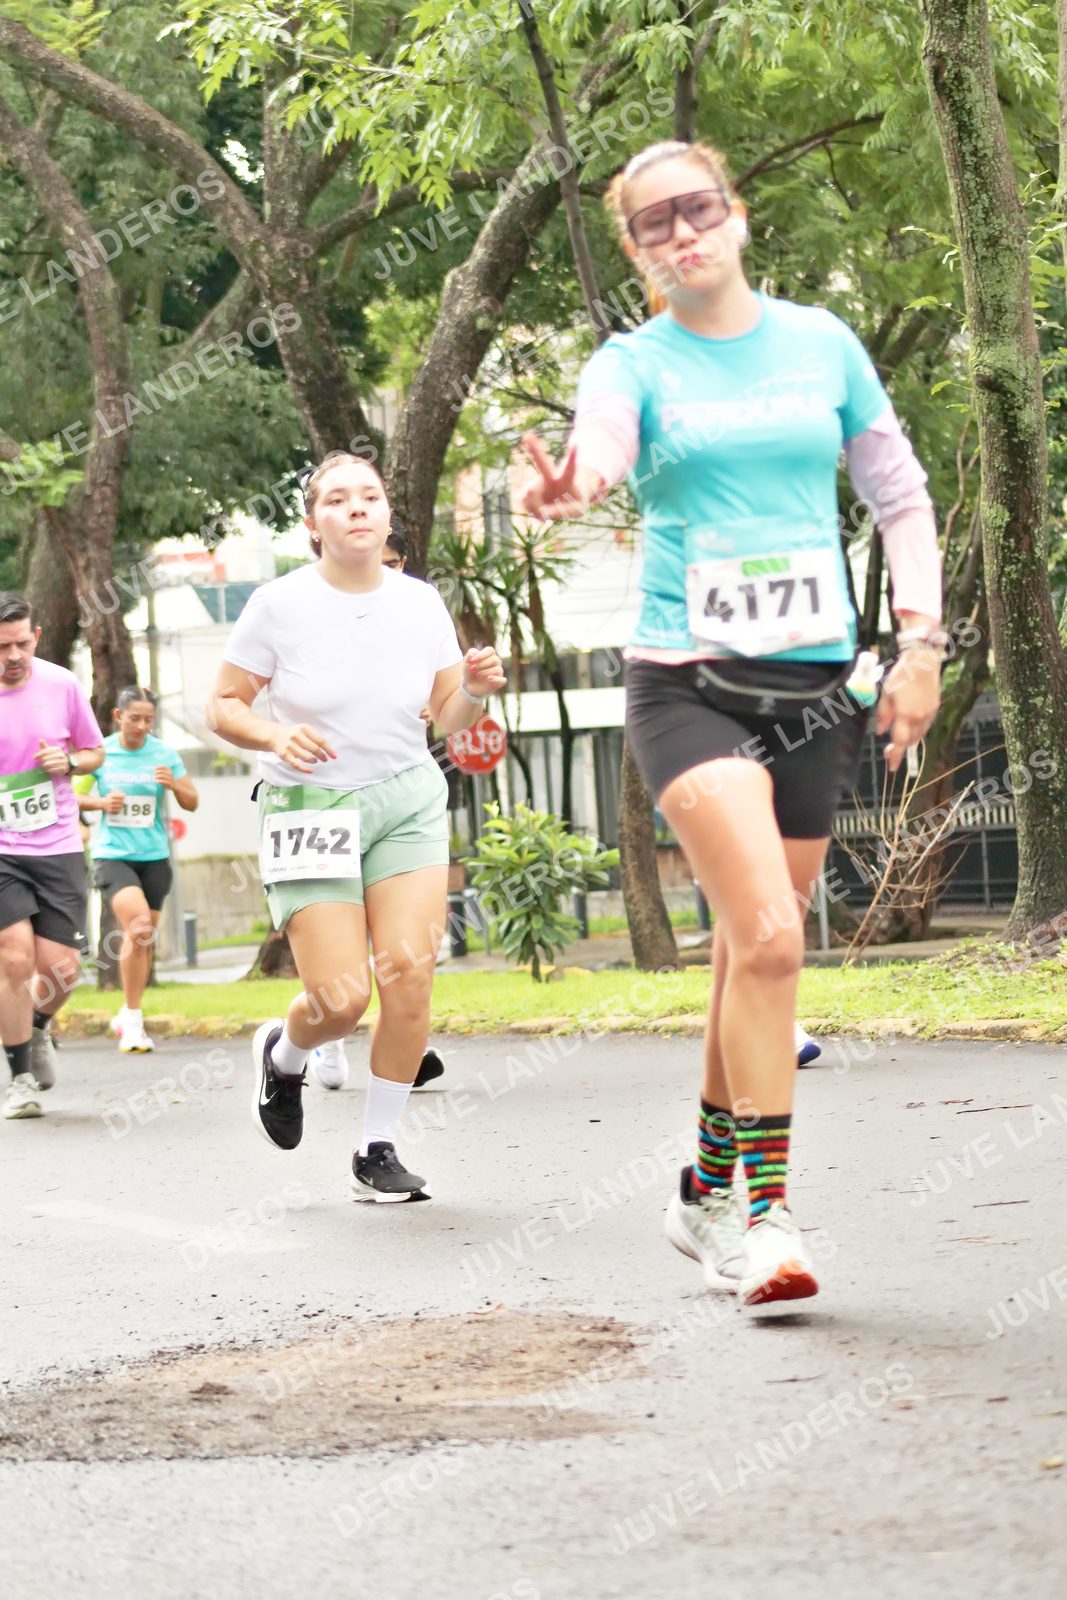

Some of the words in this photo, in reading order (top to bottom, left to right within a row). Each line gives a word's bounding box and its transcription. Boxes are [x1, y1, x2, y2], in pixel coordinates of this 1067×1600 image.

[703, 576, 821, 623] 4171
[122, 803, 151, 817] 198
[270, 826, 352, 858] 1742
